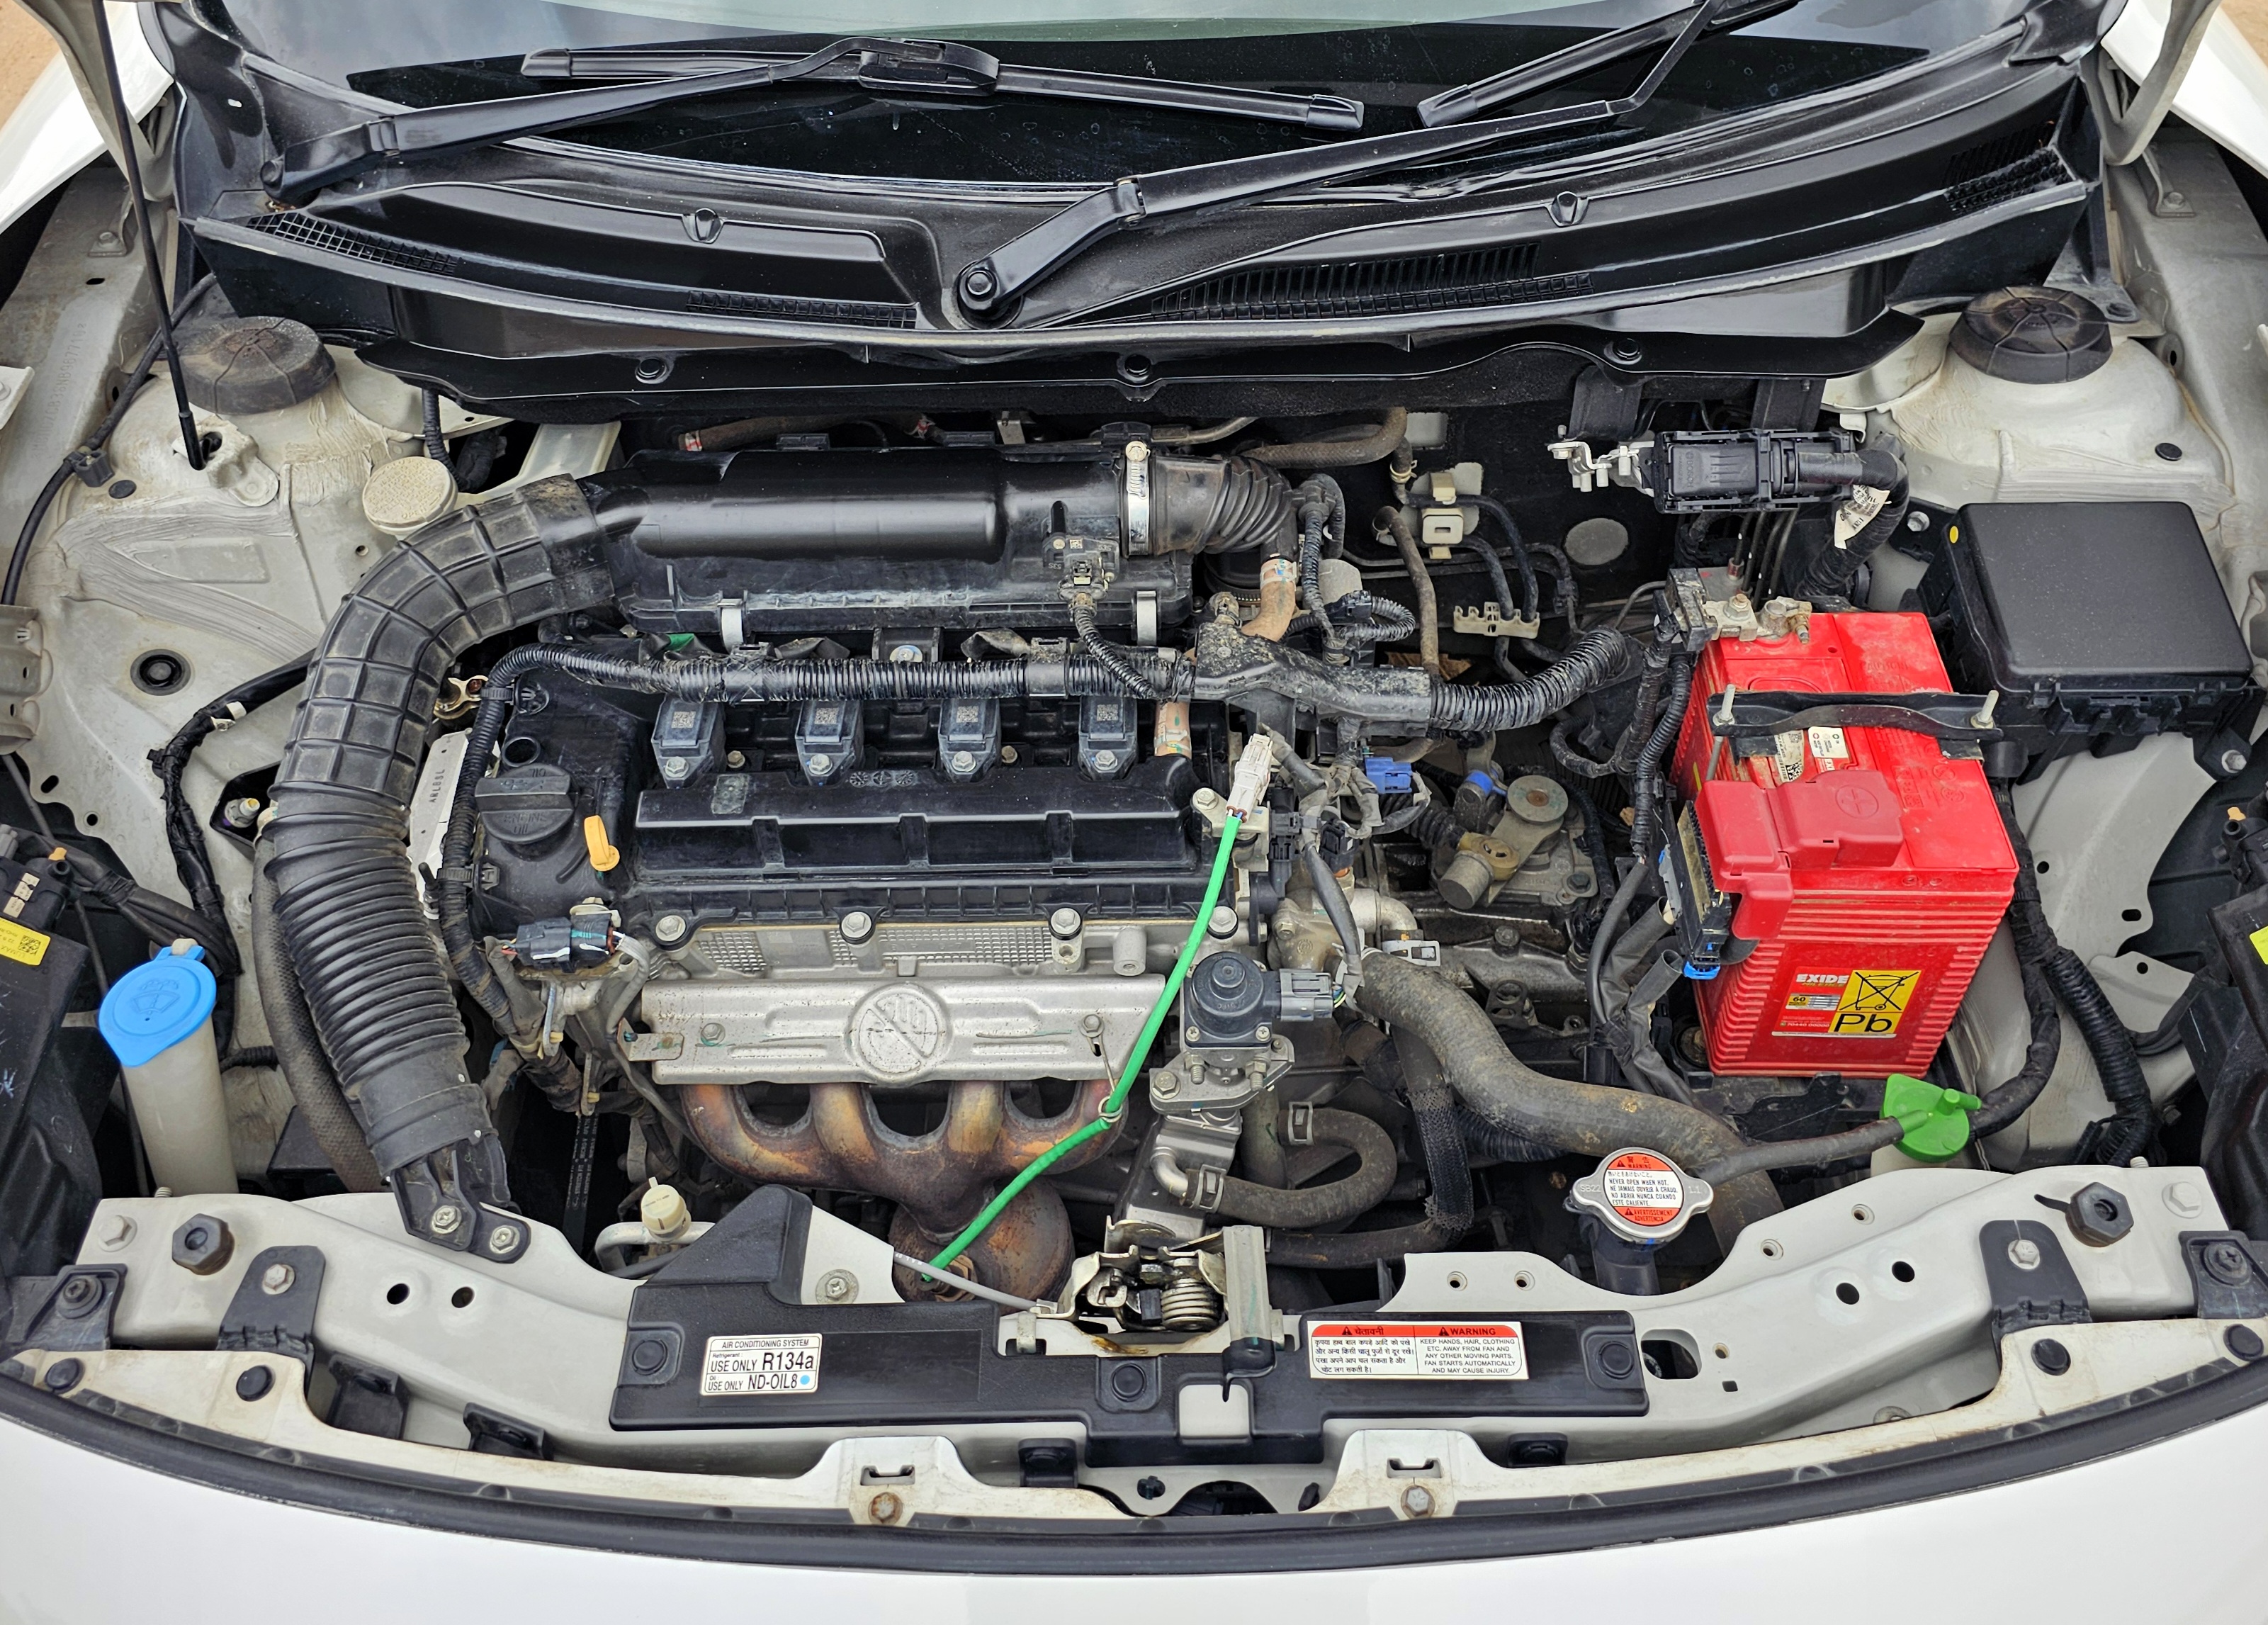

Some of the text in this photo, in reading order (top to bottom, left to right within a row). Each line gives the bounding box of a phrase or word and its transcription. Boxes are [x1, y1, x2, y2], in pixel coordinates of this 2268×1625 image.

[1796, 974, 1849, 984] EXIDE
[1834, 1013, 1892, 1033] Pb
[1355, 1326, 1384, 1335] चेतावनी
[711, 1351, 814, 1372] USE ONLY R134a
[708, 1373, 798, 1390] USE ONLY ND-OIL8
